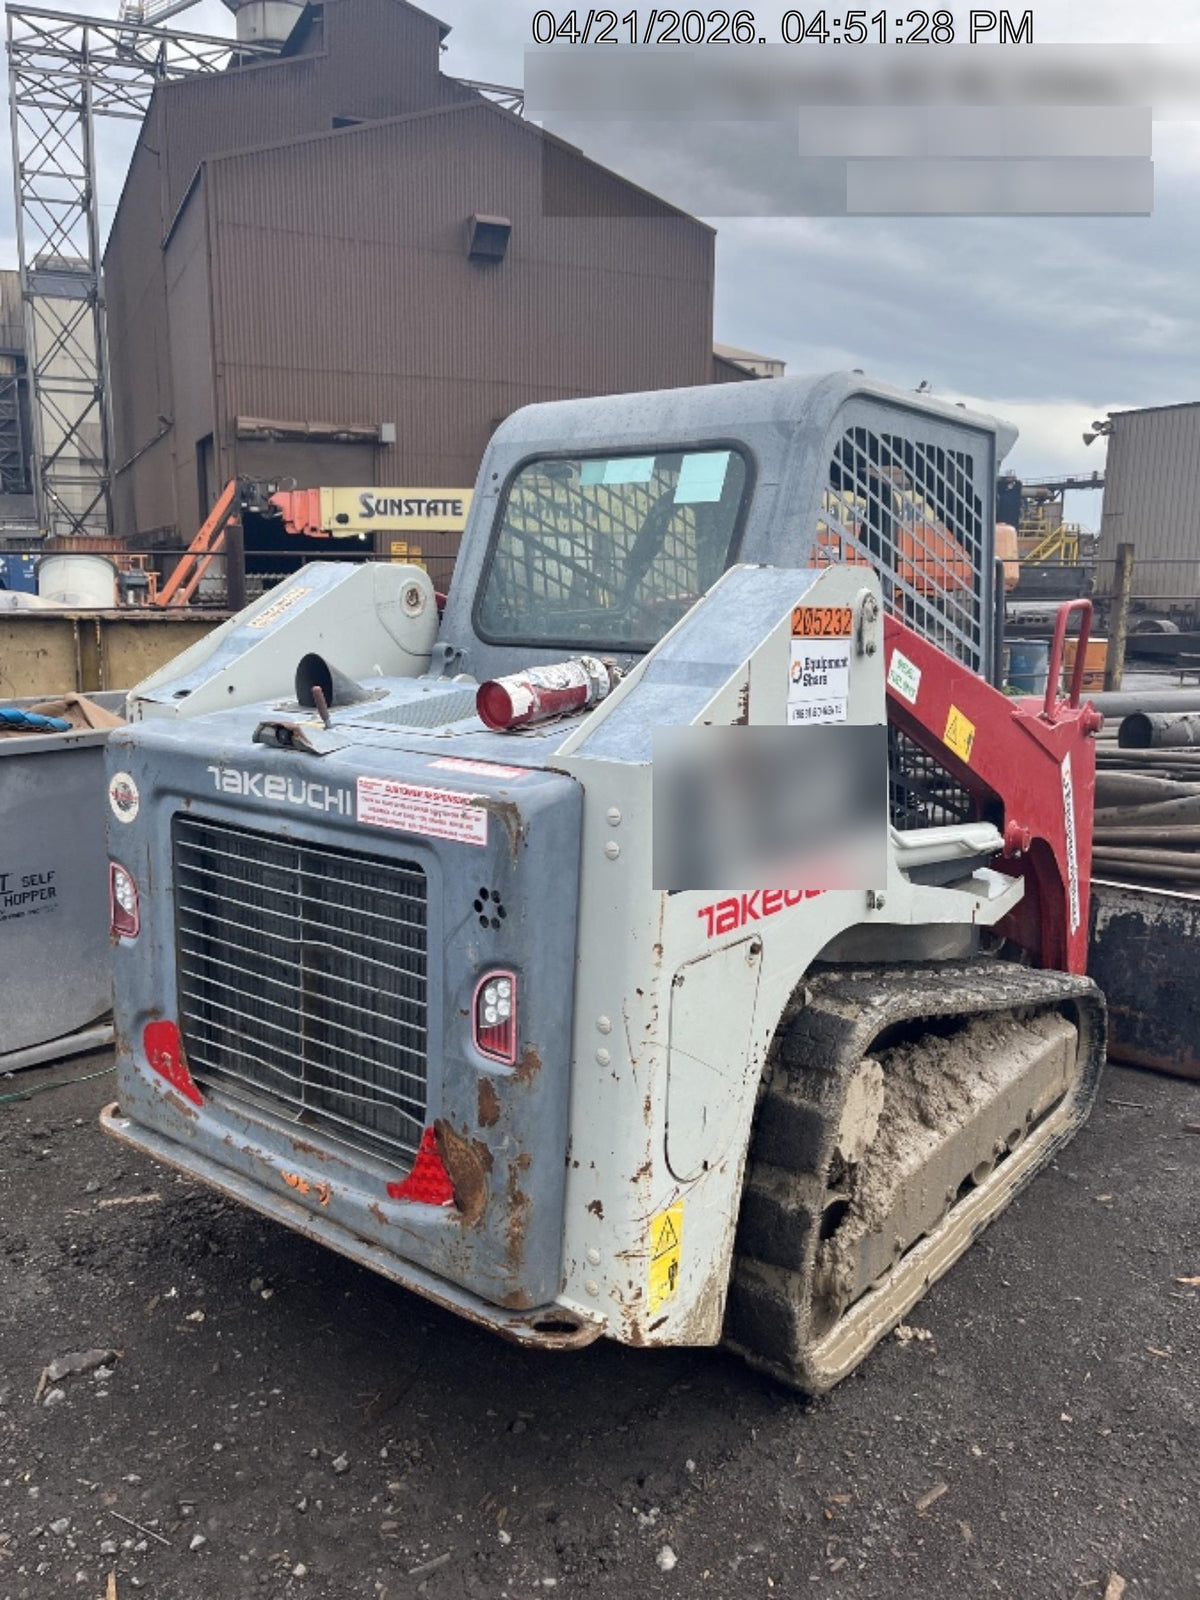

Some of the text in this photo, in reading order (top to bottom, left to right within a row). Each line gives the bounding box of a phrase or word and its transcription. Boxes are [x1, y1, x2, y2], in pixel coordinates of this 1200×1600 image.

[358, 493, 463, 518] SUNSTATE
[791, 608, 852, 635] 205232
[21, 870, 55, 888] SELF
[4, 887, 57, 907] HOPPER
